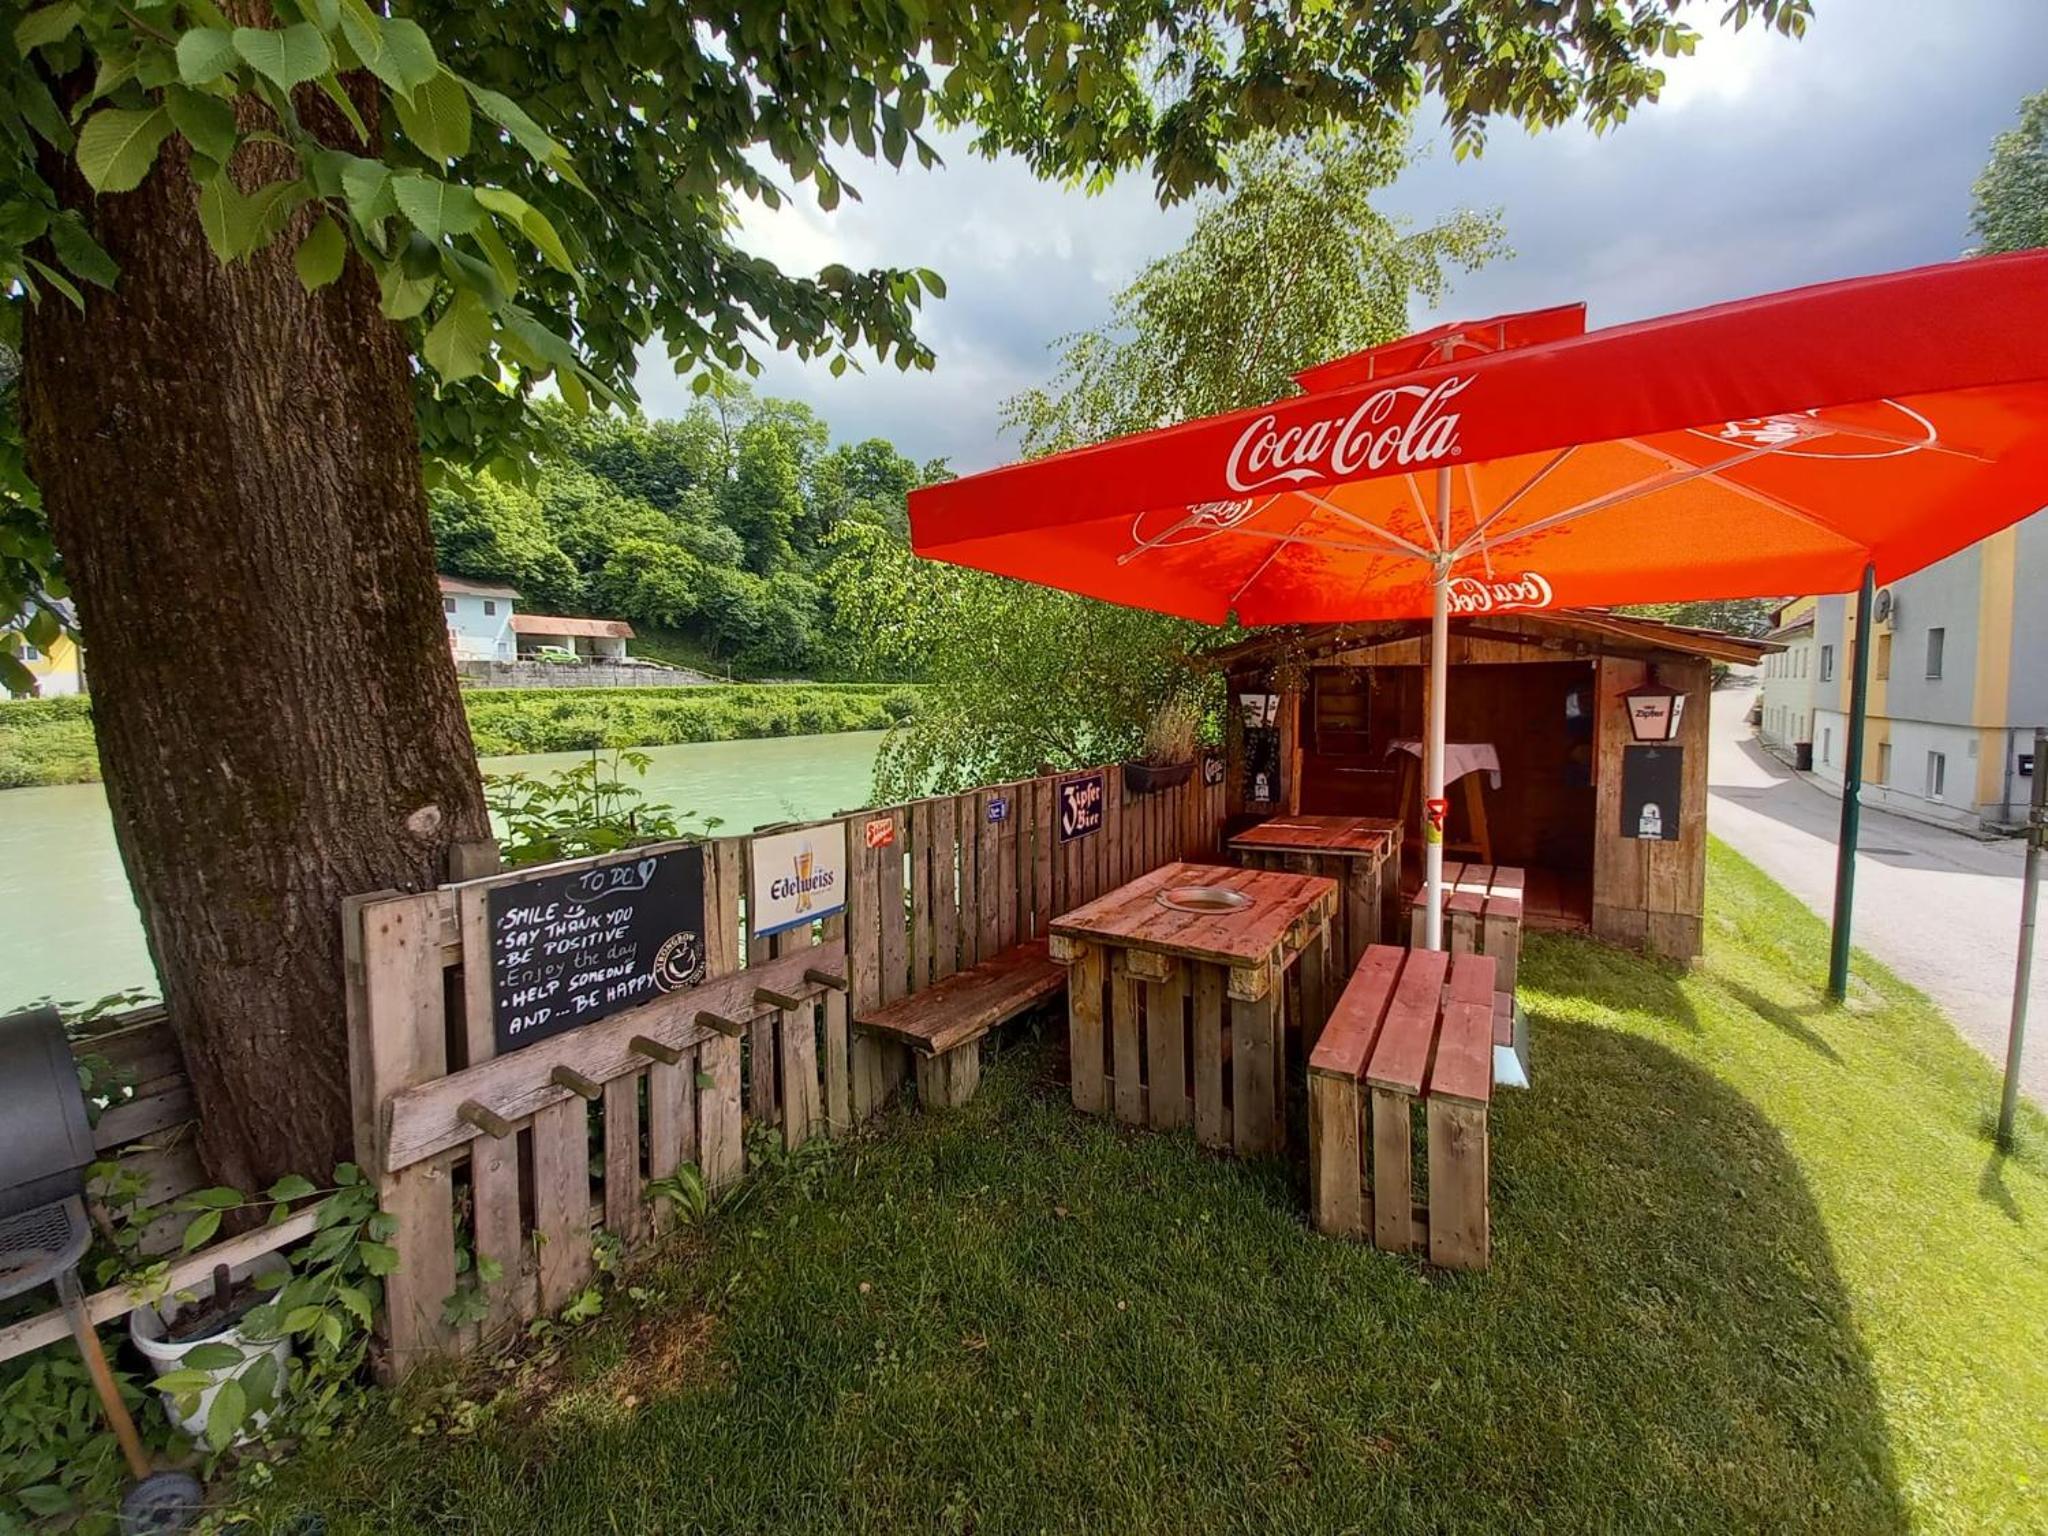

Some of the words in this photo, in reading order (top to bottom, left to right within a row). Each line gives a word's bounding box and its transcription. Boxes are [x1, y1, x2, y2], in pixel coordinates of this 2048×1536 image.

[1226, 373, 1478, 492] Coca-Cola
[580, 872, 604, 890] TO
[611, 868, 633, 885] DO
[771, 868, 834, 900] Edelweiss
[503, 903, 559, 929] SMILE
[505, 929, 540, 949] SAY
[545, 914, 601, 938] THANK
[606, 907, 633, 925] YOU
[506, 948, 534, 968] BE
[544, 925, 630, 955] POSITIVE
[507, 962, 565, 987] Enjoy
[574, 951, 600, 969] the
[607, 942, 637, 960] day
[512, 981, 560, 1007] HELP
[568, 961, 636, 992] SOMEONE
[572, 991, 600, 1014] BE
[606, 972, 655, 1002] HAPPY
